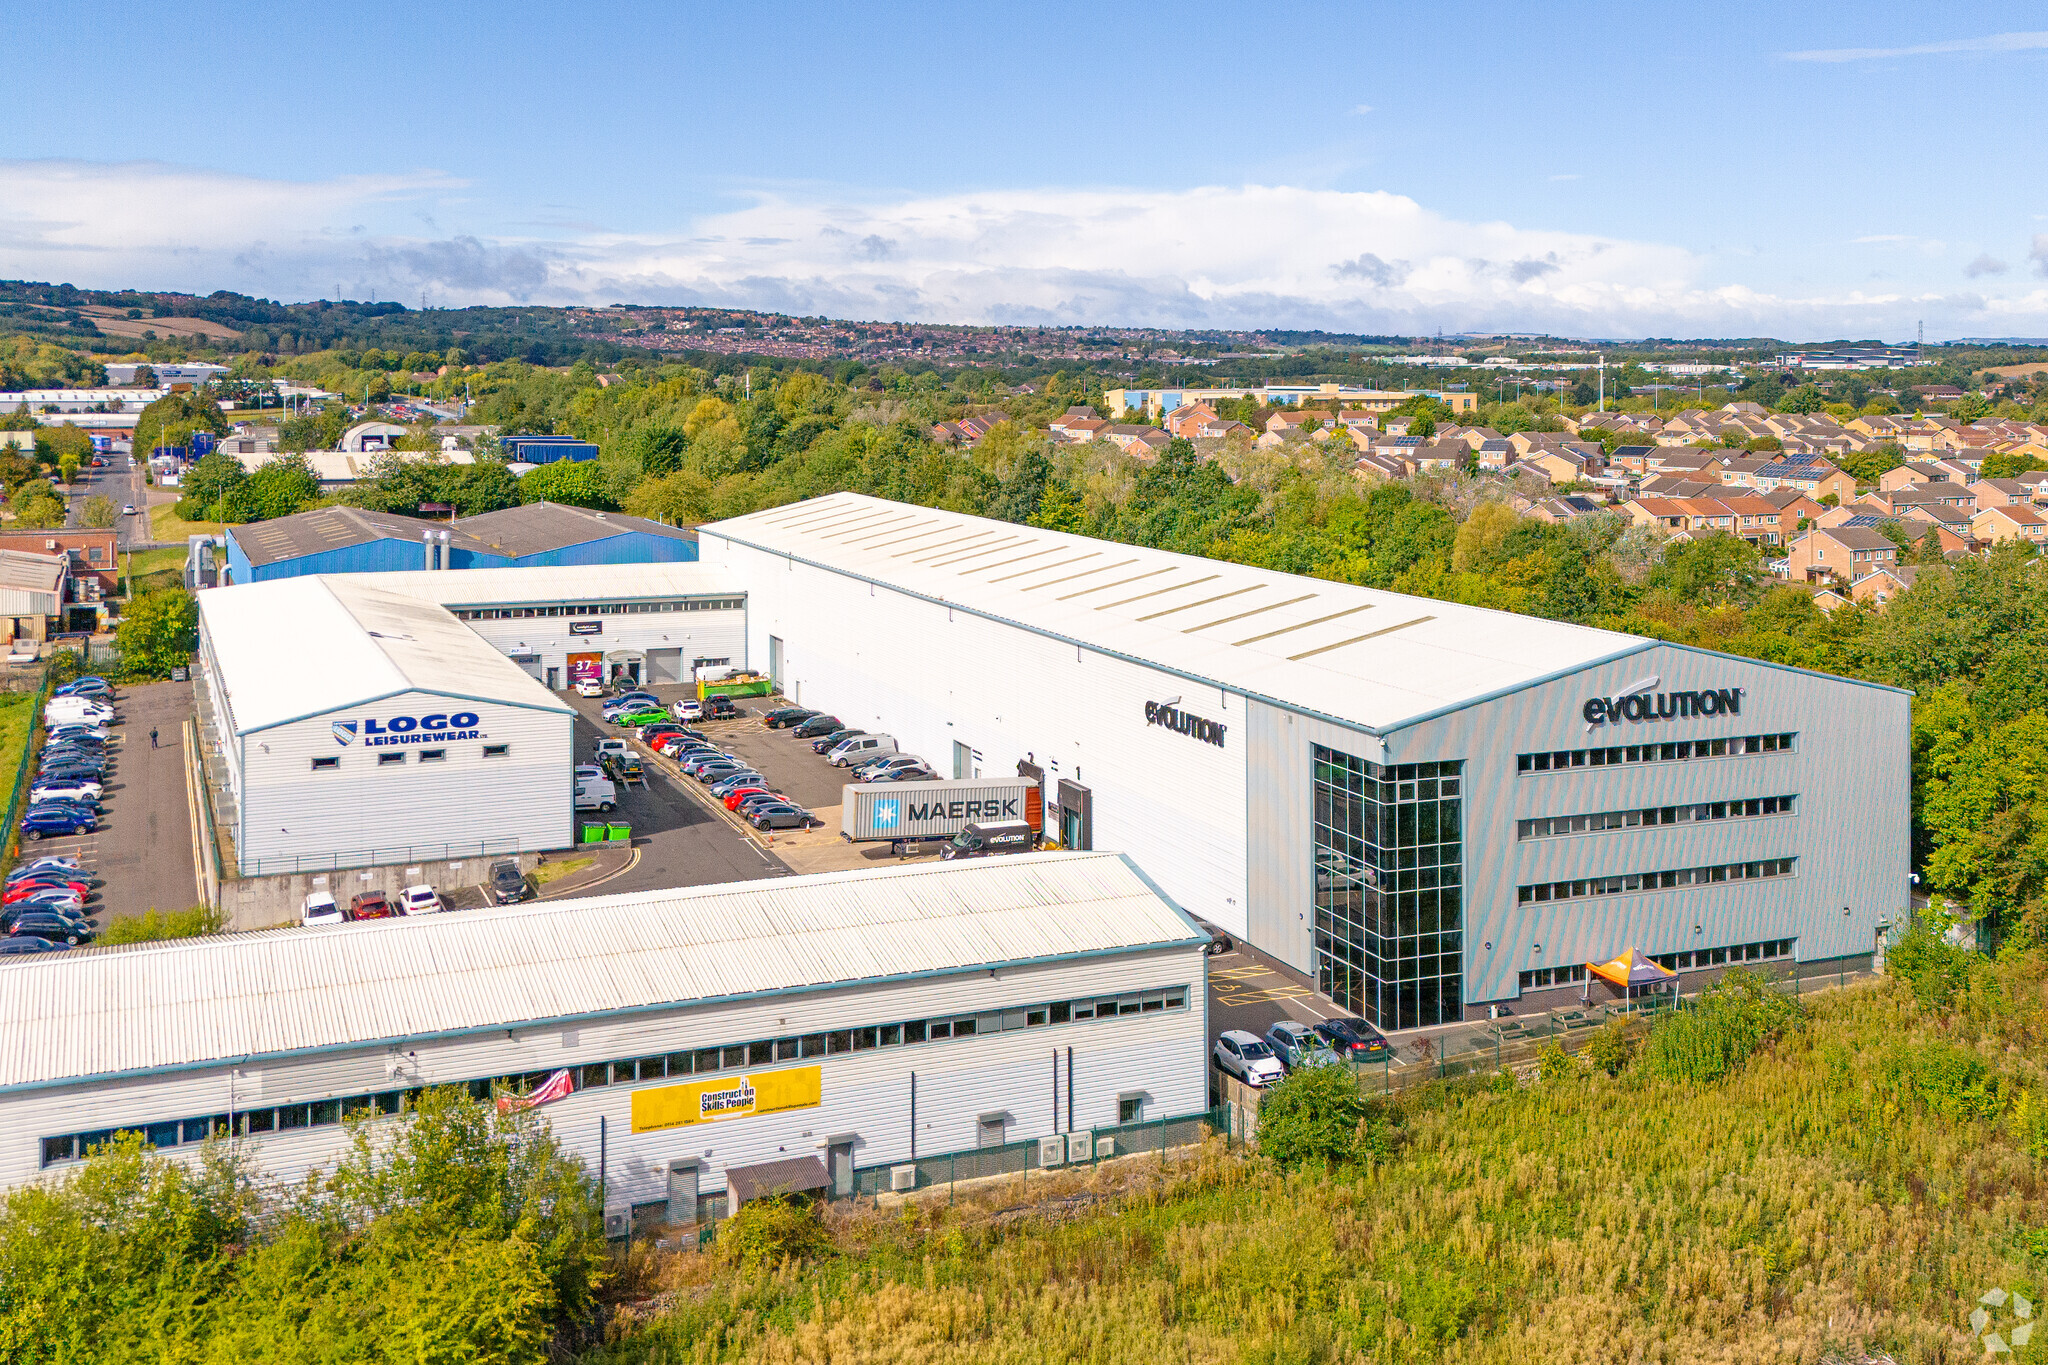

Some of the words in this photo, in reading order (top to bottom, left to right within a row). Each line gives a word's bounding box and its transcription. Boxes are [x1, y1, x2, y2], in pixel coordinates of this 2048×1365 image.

[576, 660, 592, 671] 37
[365, 712, 480, 734] LOGO
[365, 730, 479, 746] LEISUREWEAR
[908, 798, 1019, 822] MAERSK
[702, 1100, 725, 1112] Skills
[726, 1097, 755, 1109] People
